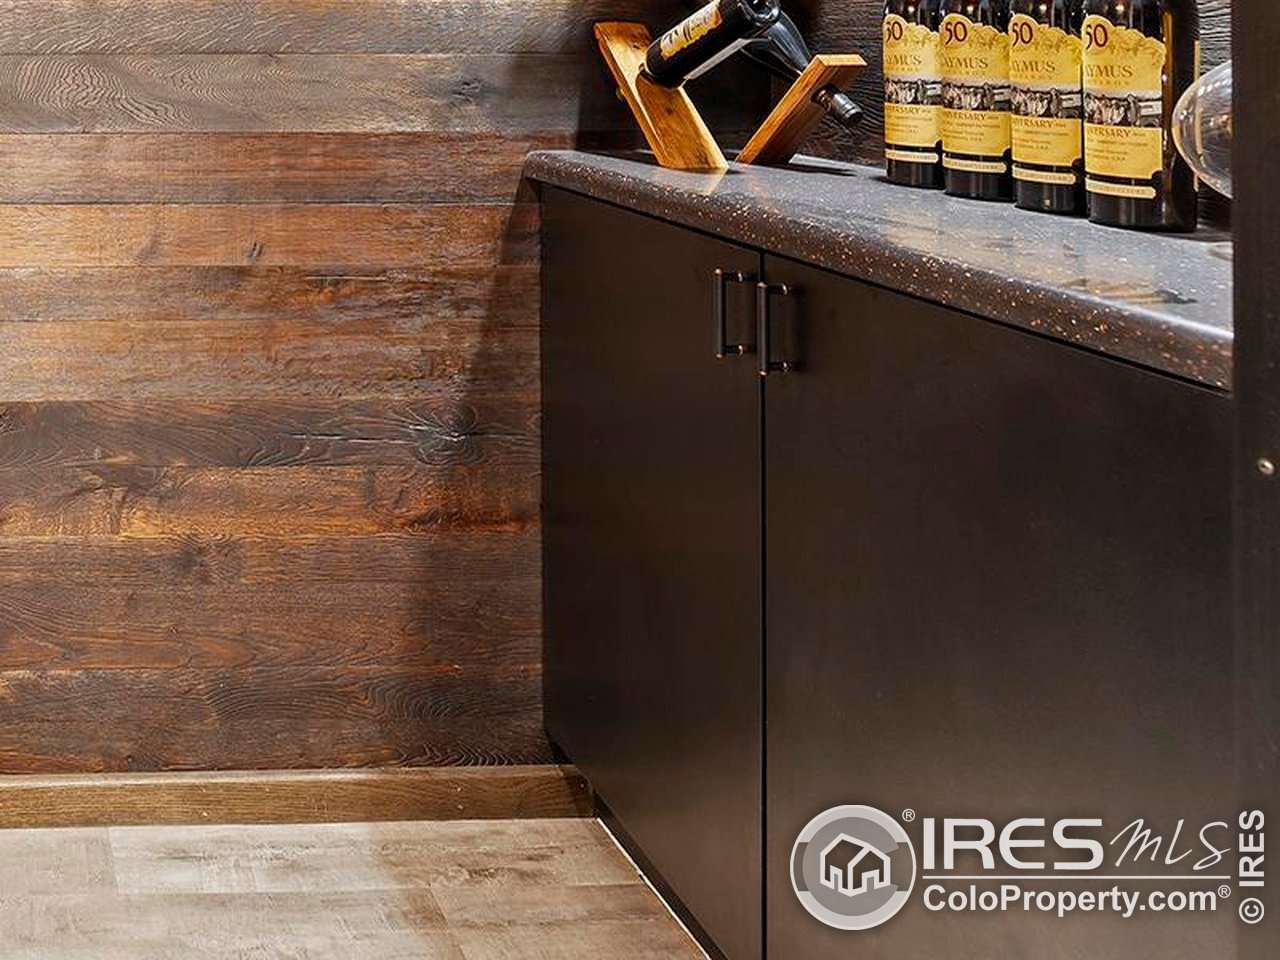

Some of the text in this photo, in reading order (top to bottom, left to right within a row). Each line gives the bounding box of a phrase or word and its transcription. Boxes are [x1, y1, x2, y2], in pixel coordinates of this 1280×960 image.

[945, 21, 967, 45] 50
[1012, 22, 1033, 47] 50
[1086, 24, 1108, 50] 50
[944, 56, 988, 69] AYMUS
[1012, 60, 1056, 74] AYMUS
[1085, 63, 1134, 79] AYMUS
